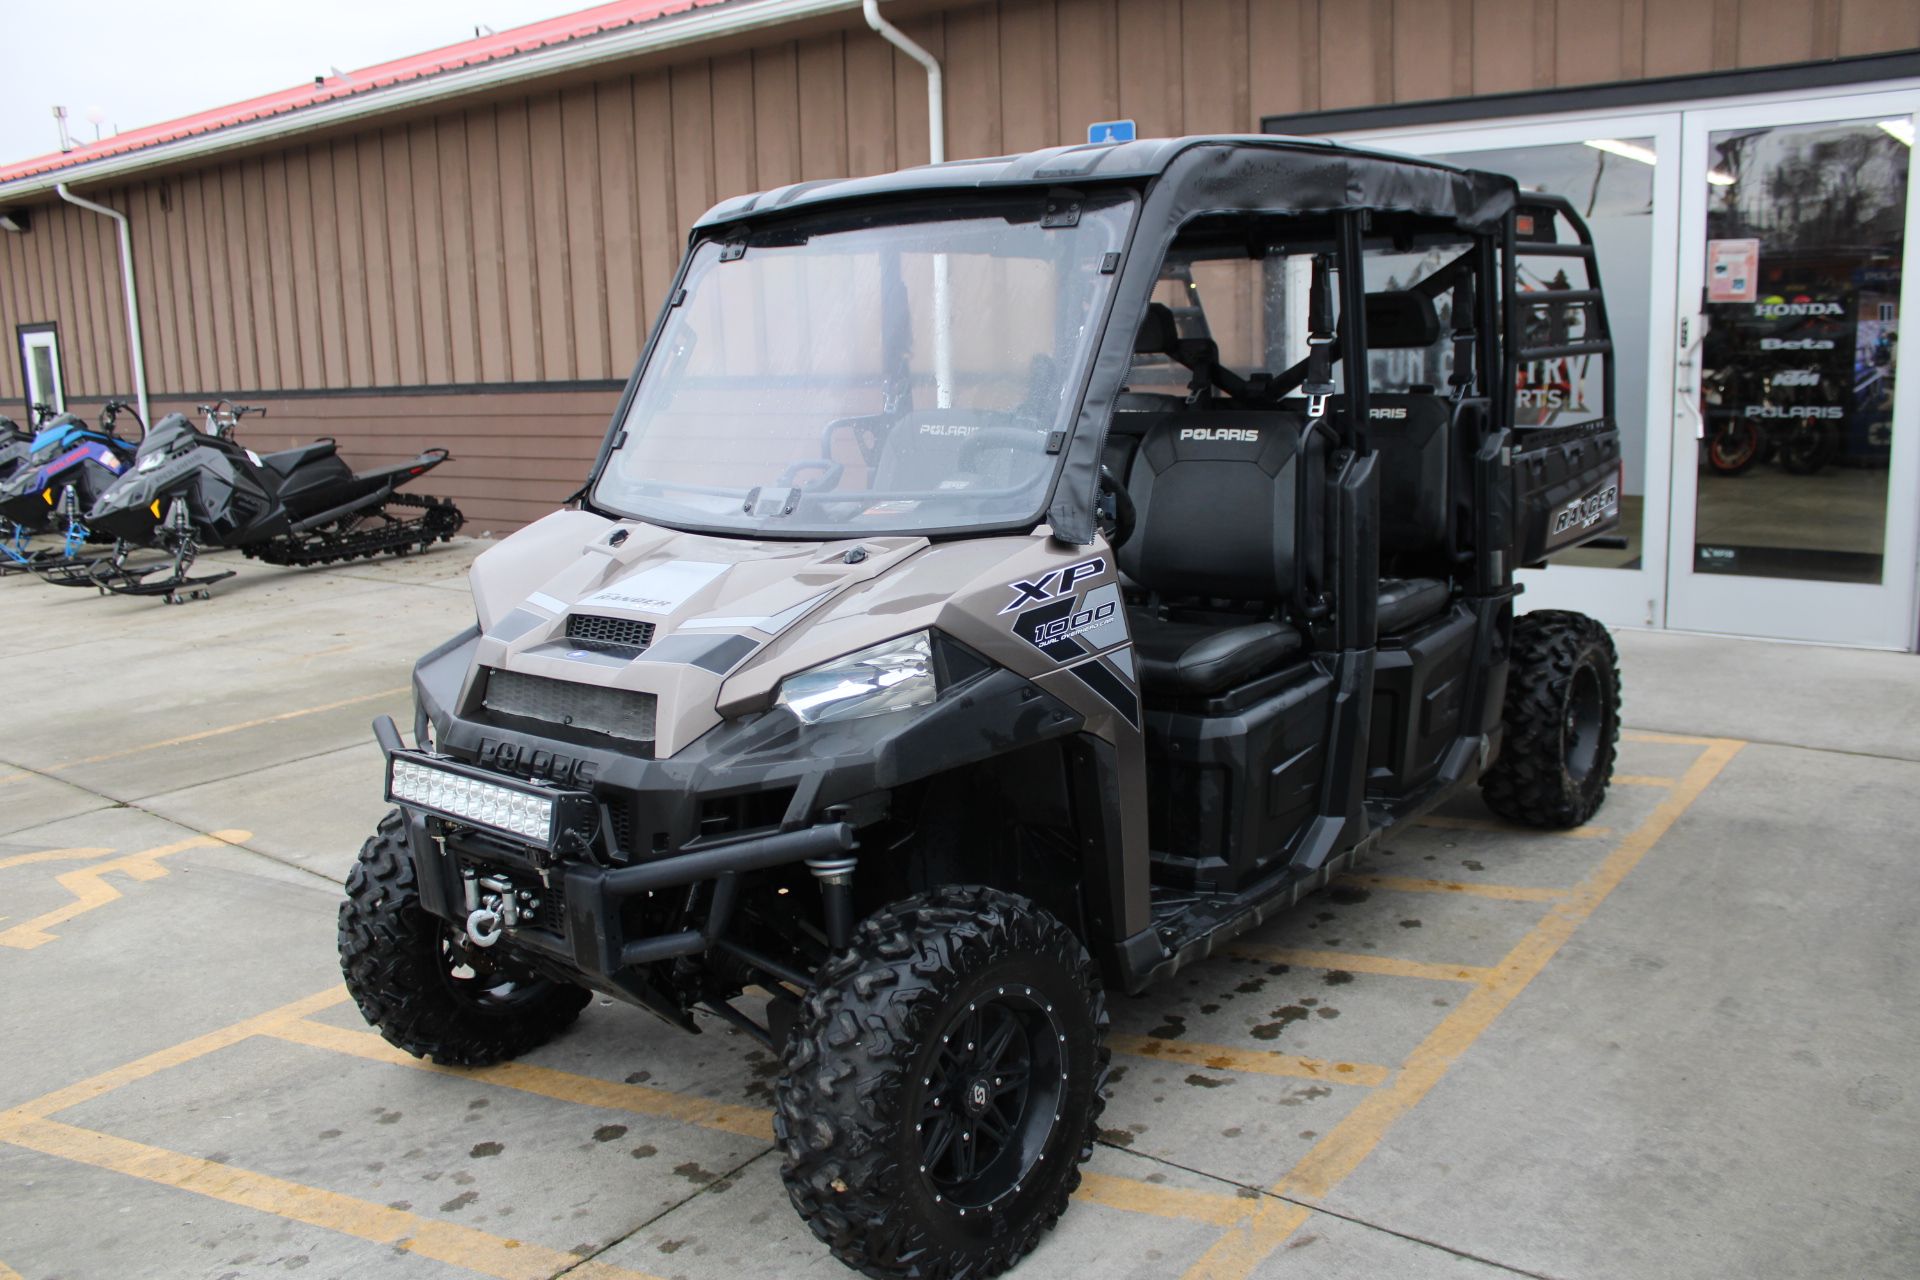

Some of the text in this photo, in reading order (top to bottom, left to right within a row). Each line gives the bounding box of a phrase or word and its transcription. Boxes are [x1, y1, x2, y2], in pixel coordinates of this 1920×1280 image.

[1754, 302, 1844, 316] HONDA
[1760, 338, 1834, 350] Beta
[1772, 369, 1820, 386] KTM
[1369, 408, 1407, 419] ARIS
[1745, 406, 1844, 419] POLARIS
[1180, 428, 1259, 442] POLARIS
[1552, 485, 1617, 535] RANGER
[997, 556, 1106, 615] XP
[1034, 601, 1117, 643] 1000
[478, 737, 599, 793] POLARIS
